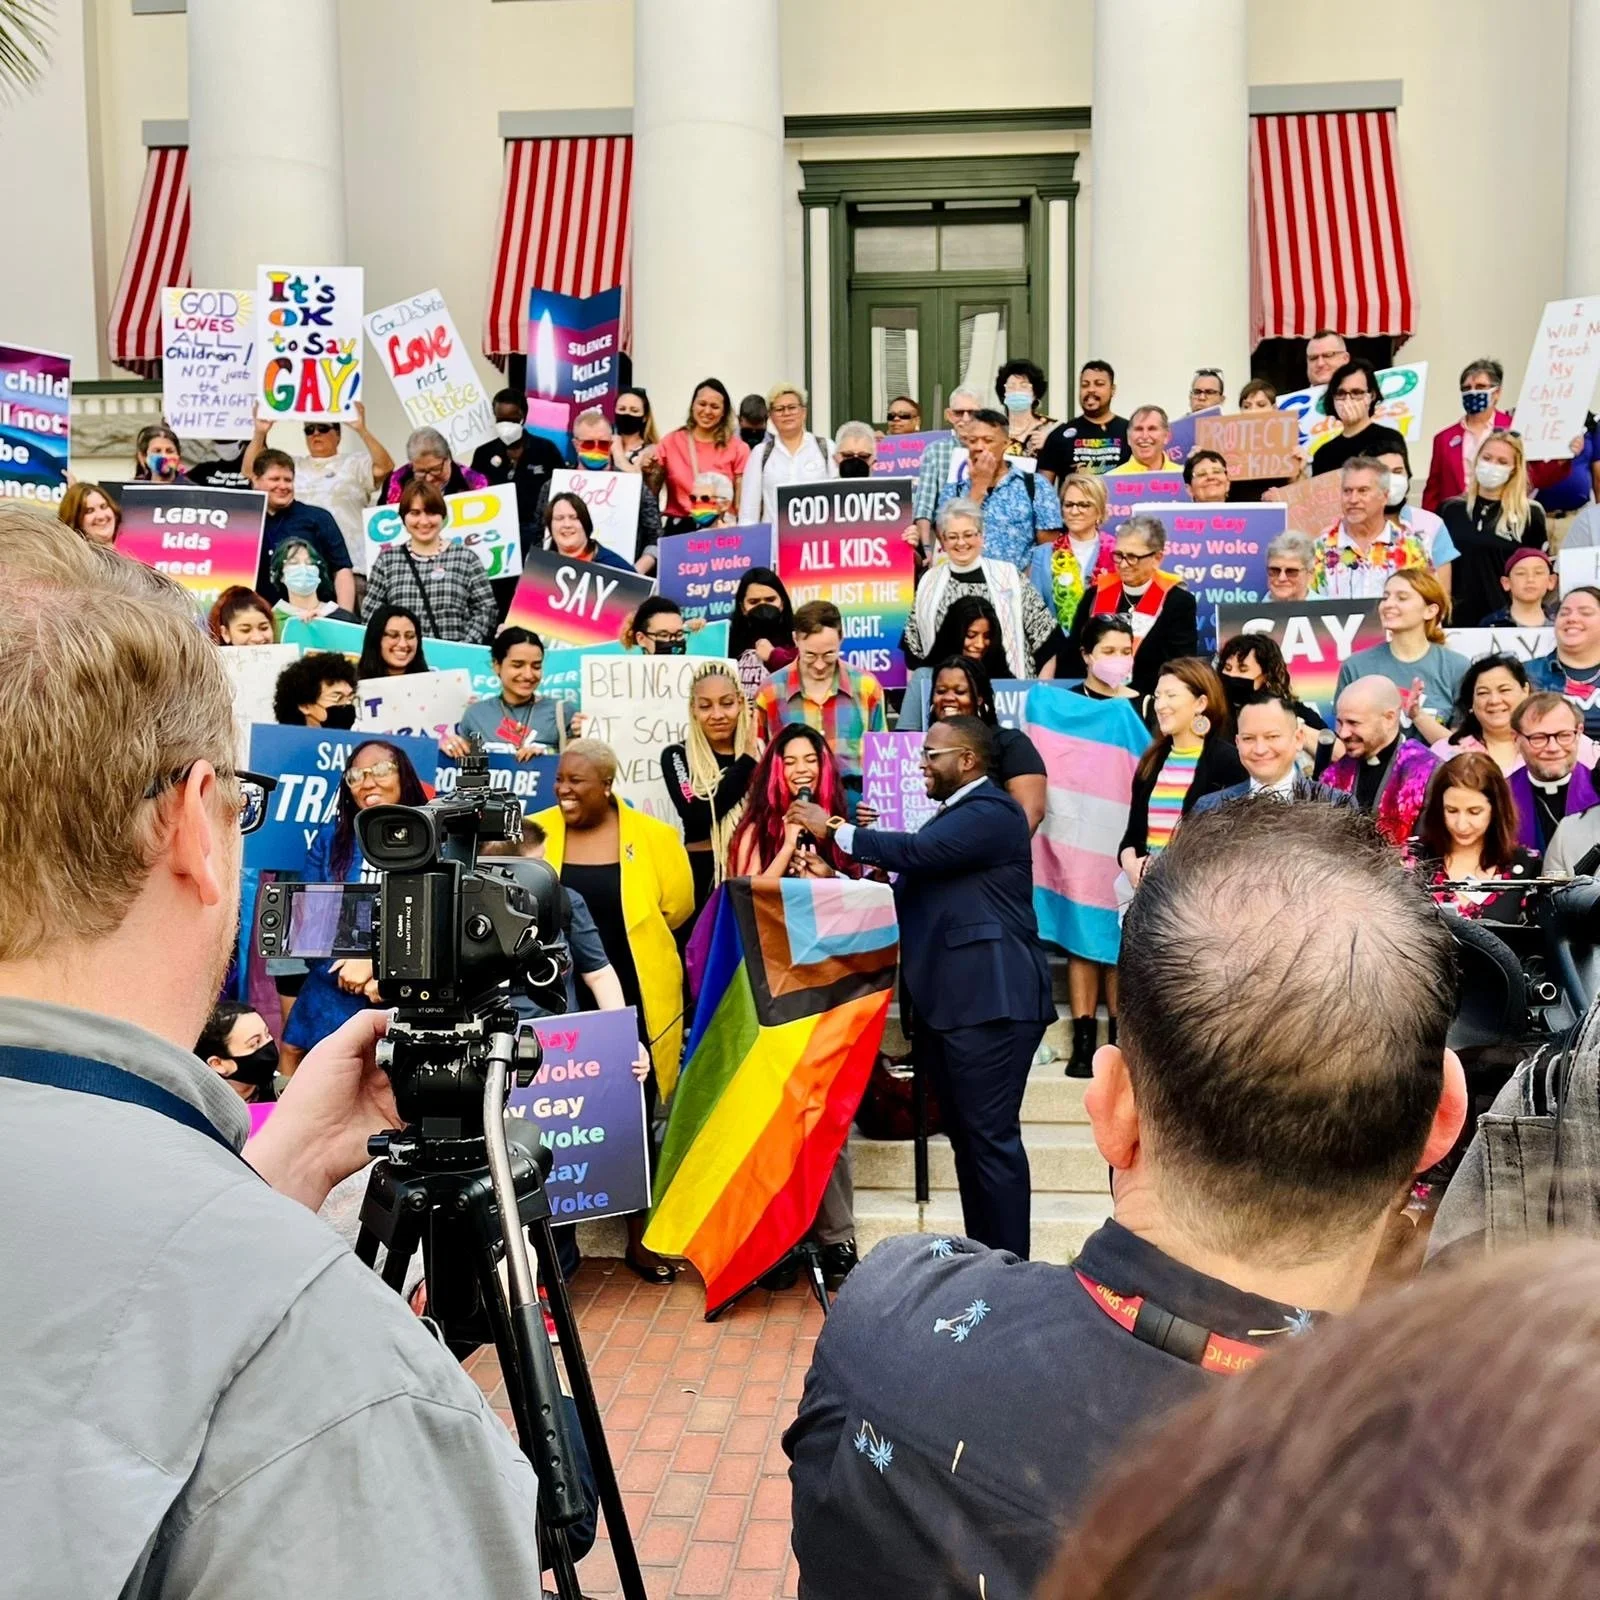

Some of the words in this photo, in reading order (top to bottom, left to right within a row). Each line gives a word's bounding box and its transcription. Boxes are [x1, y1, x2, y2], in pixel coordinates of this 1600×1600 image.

[266, 270, 336, 304] It's
[180, 291, 240, 318] GOD
[268, 306, 334, 327] OK
[1573, 302, 1584, 317] I
[173, 316, 236, 333] LOVES
[172, 331, 243, 349] ALL
[267, 330, 298, 353] to
[303, 332, 357, 366] Say
[387, 324, 454, 378] Love
[567, 333, 613, 357] SILENCE
[181, 364, 220, 378] NOT
[221, 369, 251, 384] just
[415, 363, 448, 390] not
[571, 356, 611, 382] KILLS
[4, 368, 69, 400] child
[263, 356, 361, 413] GAY!
[572, 381, 609, 404] TRANS
[18, 409, 65, 435] not
[169, 411, 230, 428] WHITE
[1200, 417, 1297, 451] PROTECT
[1246, 452, 1295, 477] KIDS
[152, 507, 229, 529] LGBTQ
[787, 495, 830, 527] GOD
[833, 491, 901, 524] LOVES
[1173, 516, 1207, 534] Say
[1210, 515, 1247, 534] Gay
[162, 531, 212, 551] kids
[1206, 539, 1259, 555] Woke
[677, 561, 708, 577] Stay
[710, 554, 752, 571] Woke
[799, 539, 835, 572] ALL
[838, 536, 892, 569] KIDS.
[1173, 563, 1208, 584] Say
[1209, 563, 1247, 583] Gay
[547, 565, 620, 622] SAY
[685, 582, 712, 599] Say
[712, 579, 741, 595] Gay
[828, 582, 865, 605] JUST
[869, 580, 900, 603] THE
[1205, 587, 1258, 603] Woke
[848, 648, 892, 672] ONES
[589, 661, 672, 699] BEING
[866, 760, 895, 779] ALL
[513, 769, 541, 797] BE
[867, 780, 896, 799] ALL
[867, 797, 898, 814] ALL
[532, 1095, 585, 1120] Gay
